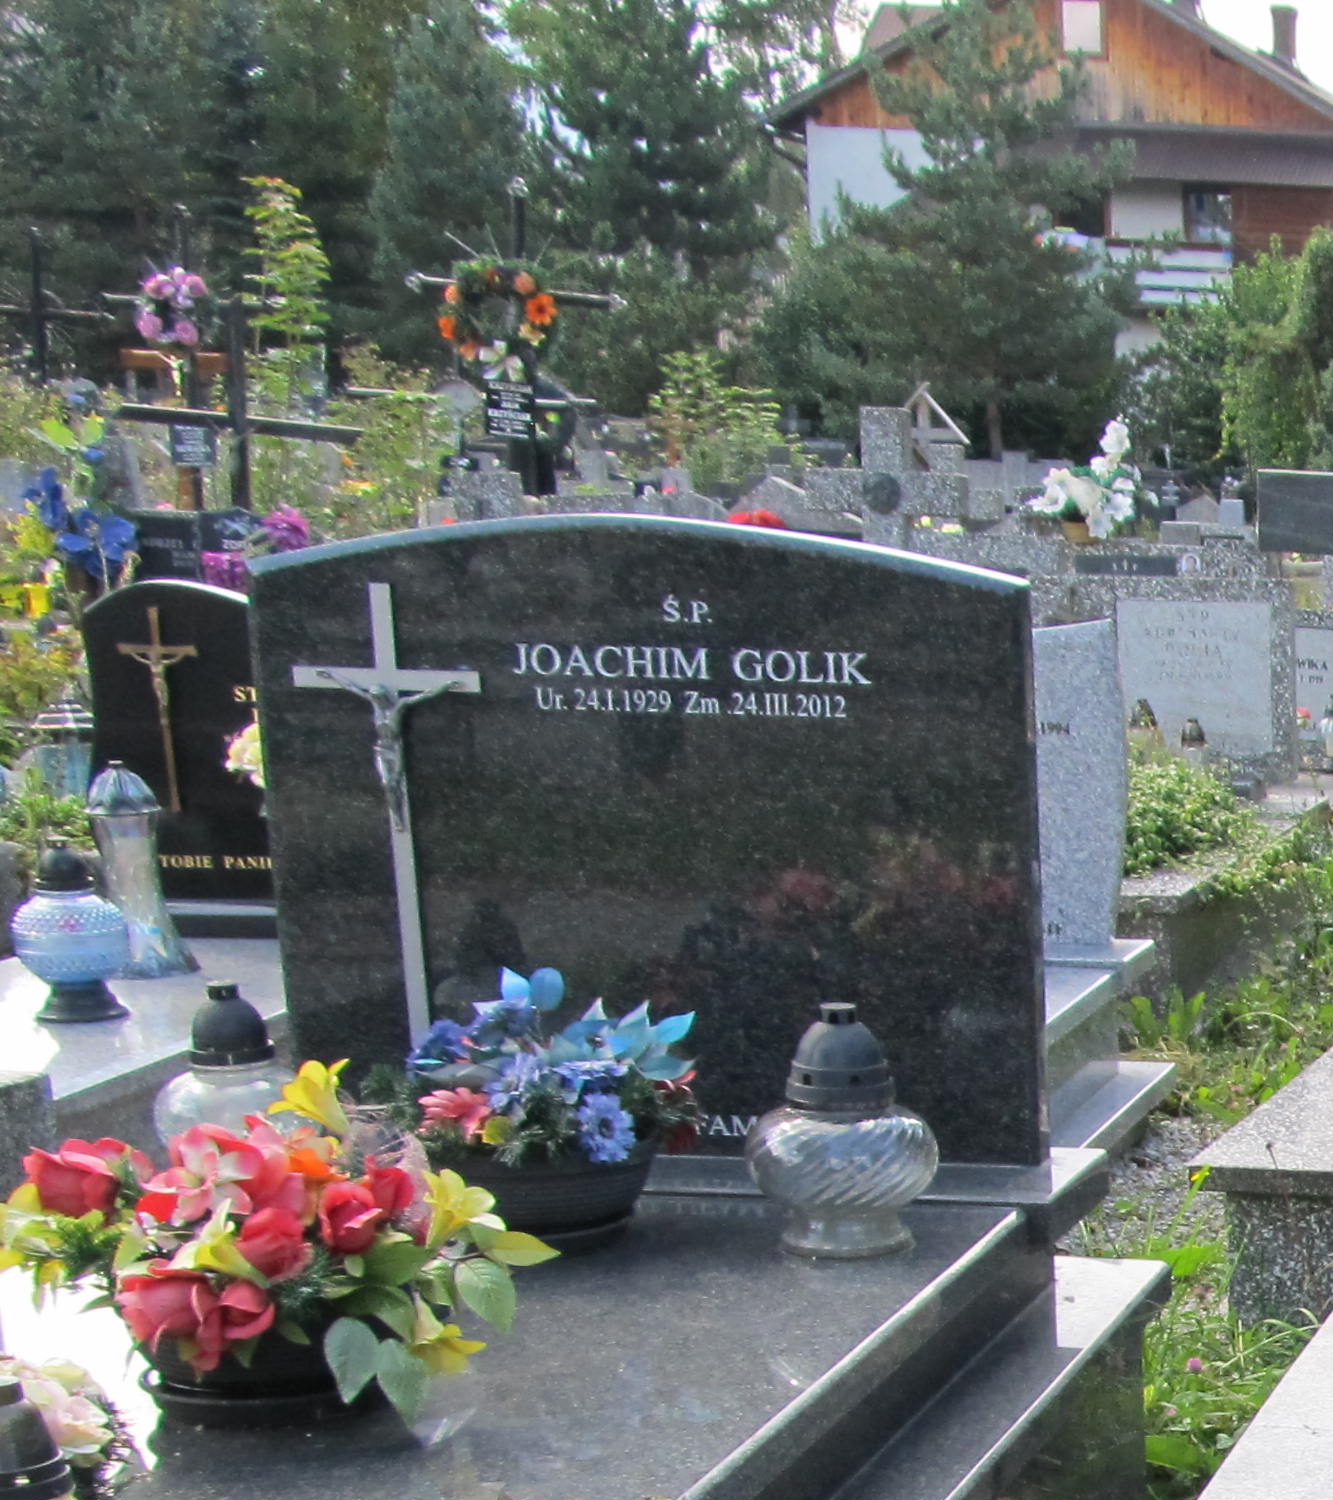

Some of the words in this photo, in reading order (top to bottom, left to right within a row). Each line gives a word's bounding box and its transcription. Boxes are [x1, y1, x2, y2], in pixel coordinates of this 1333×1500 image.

[512, 643, 711, 680] JOACHIM
[732, 649, 872, 685] GOLIK
[535, 686, 567, 710] Ur.
[574, 688, 672, 713] 24.I.1929
[158, 854, 214, 870] TOBIE
